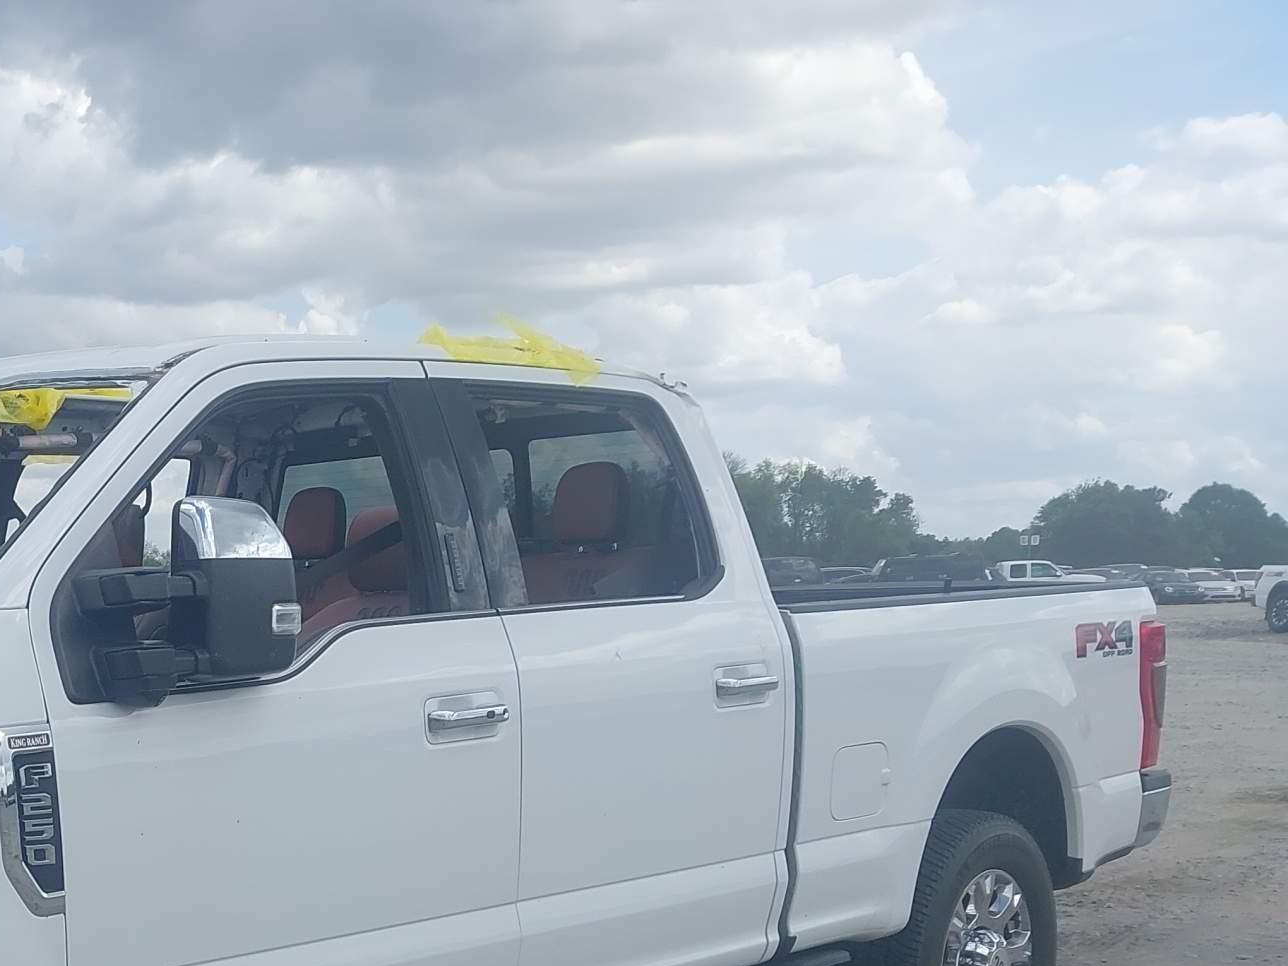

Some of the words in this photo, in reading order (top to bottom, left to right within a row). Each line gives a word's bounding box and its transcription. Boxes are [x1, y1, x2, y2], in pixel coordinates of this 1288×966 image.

[1076, 620, 1133, 658] FX4
[10, 737, 27, 748] KING
[27, 735, 48, 747] RANCH
